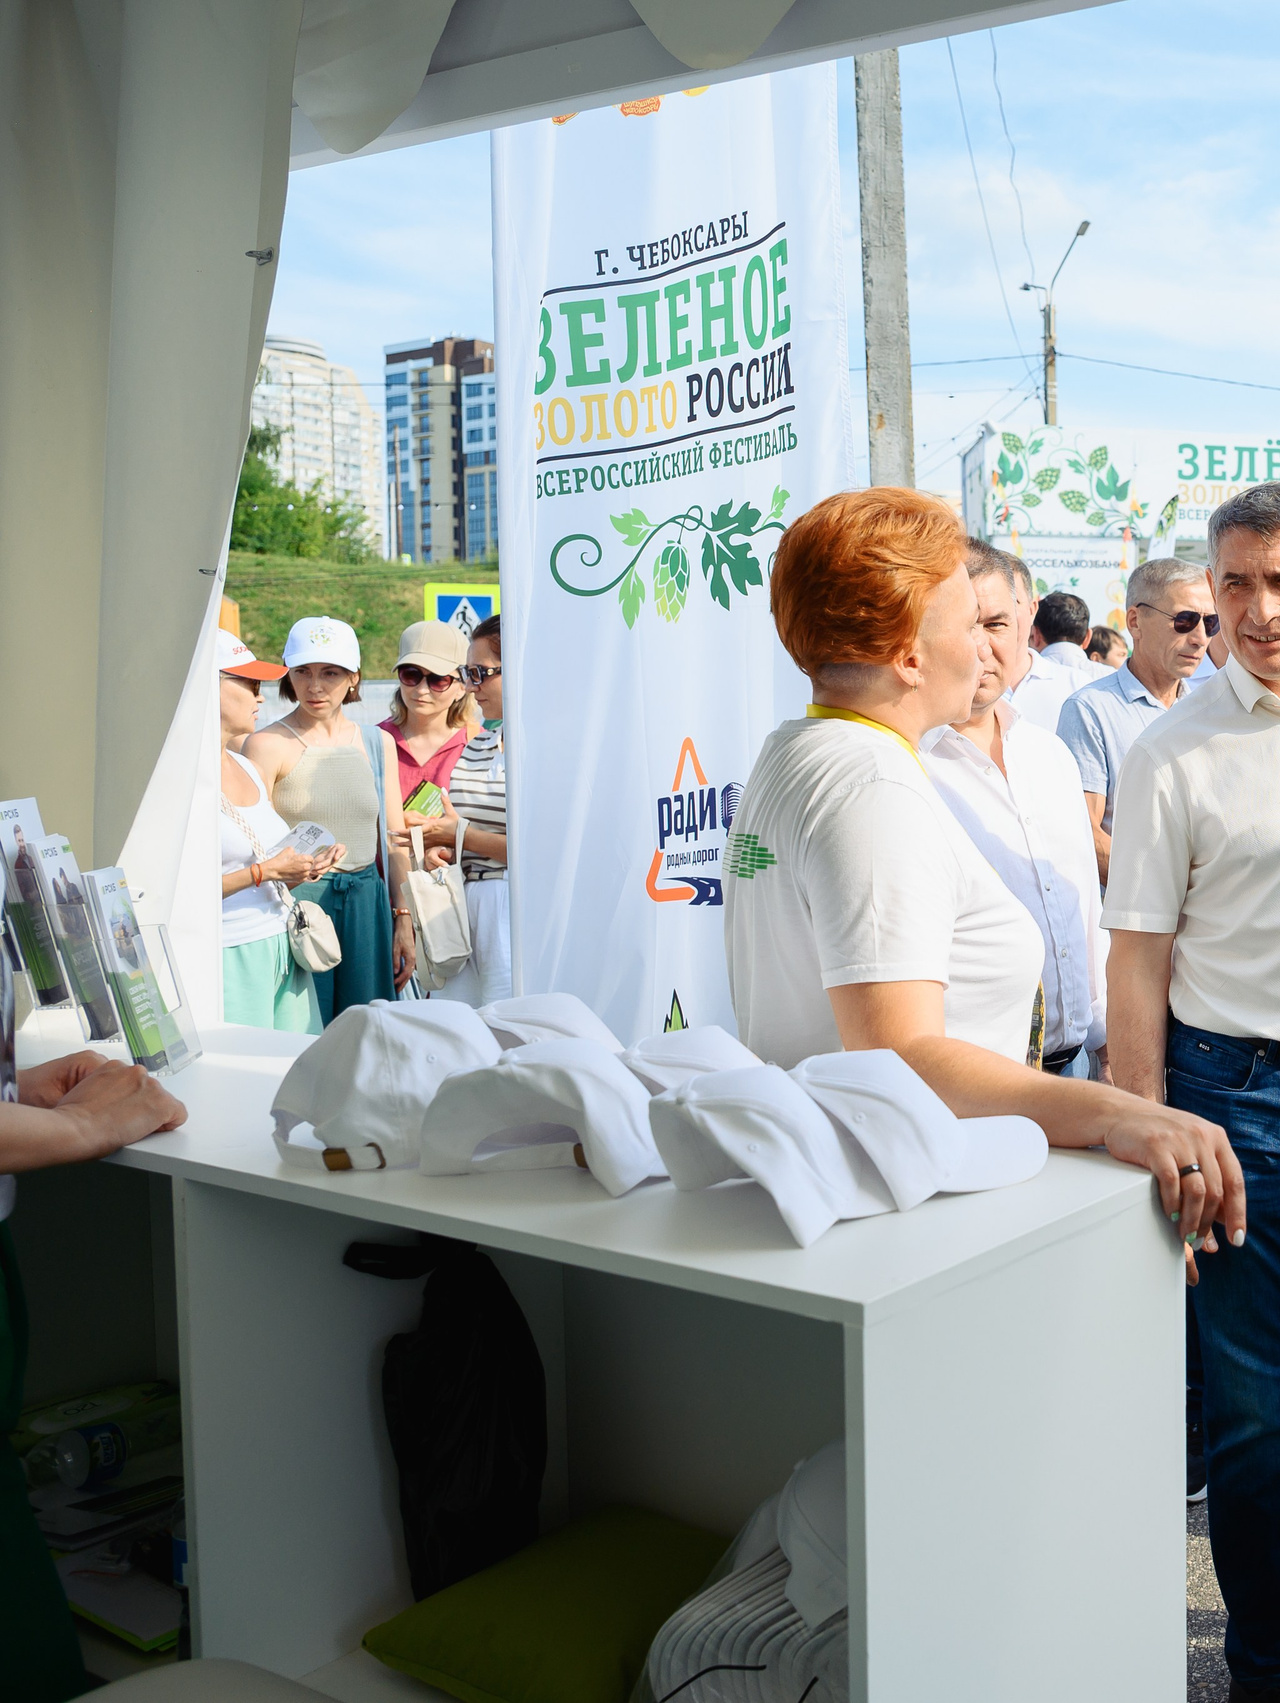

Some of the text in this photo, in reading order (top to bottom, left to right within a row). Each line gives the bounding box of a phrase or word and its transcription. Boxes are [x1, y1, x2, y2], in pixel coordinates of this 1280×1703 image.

[594, 211, 749, 276] Г. ЧЕБОКСАРЫ
[534, 238, 792, 395] ЗЕЛЕНОЕ
[533, 342, 795, 450] ЗОЛОТО РОССИИ
[536, 422, 798, 499] ВСЕРОССИЙСКИЙ ФЕСТИВАЛЬ
[1178, 483, 1247, 505] ЗОЛО
[1178, 509, 1211, 520] ВСЕР
[667, 848, 720, 870] родных дорог
